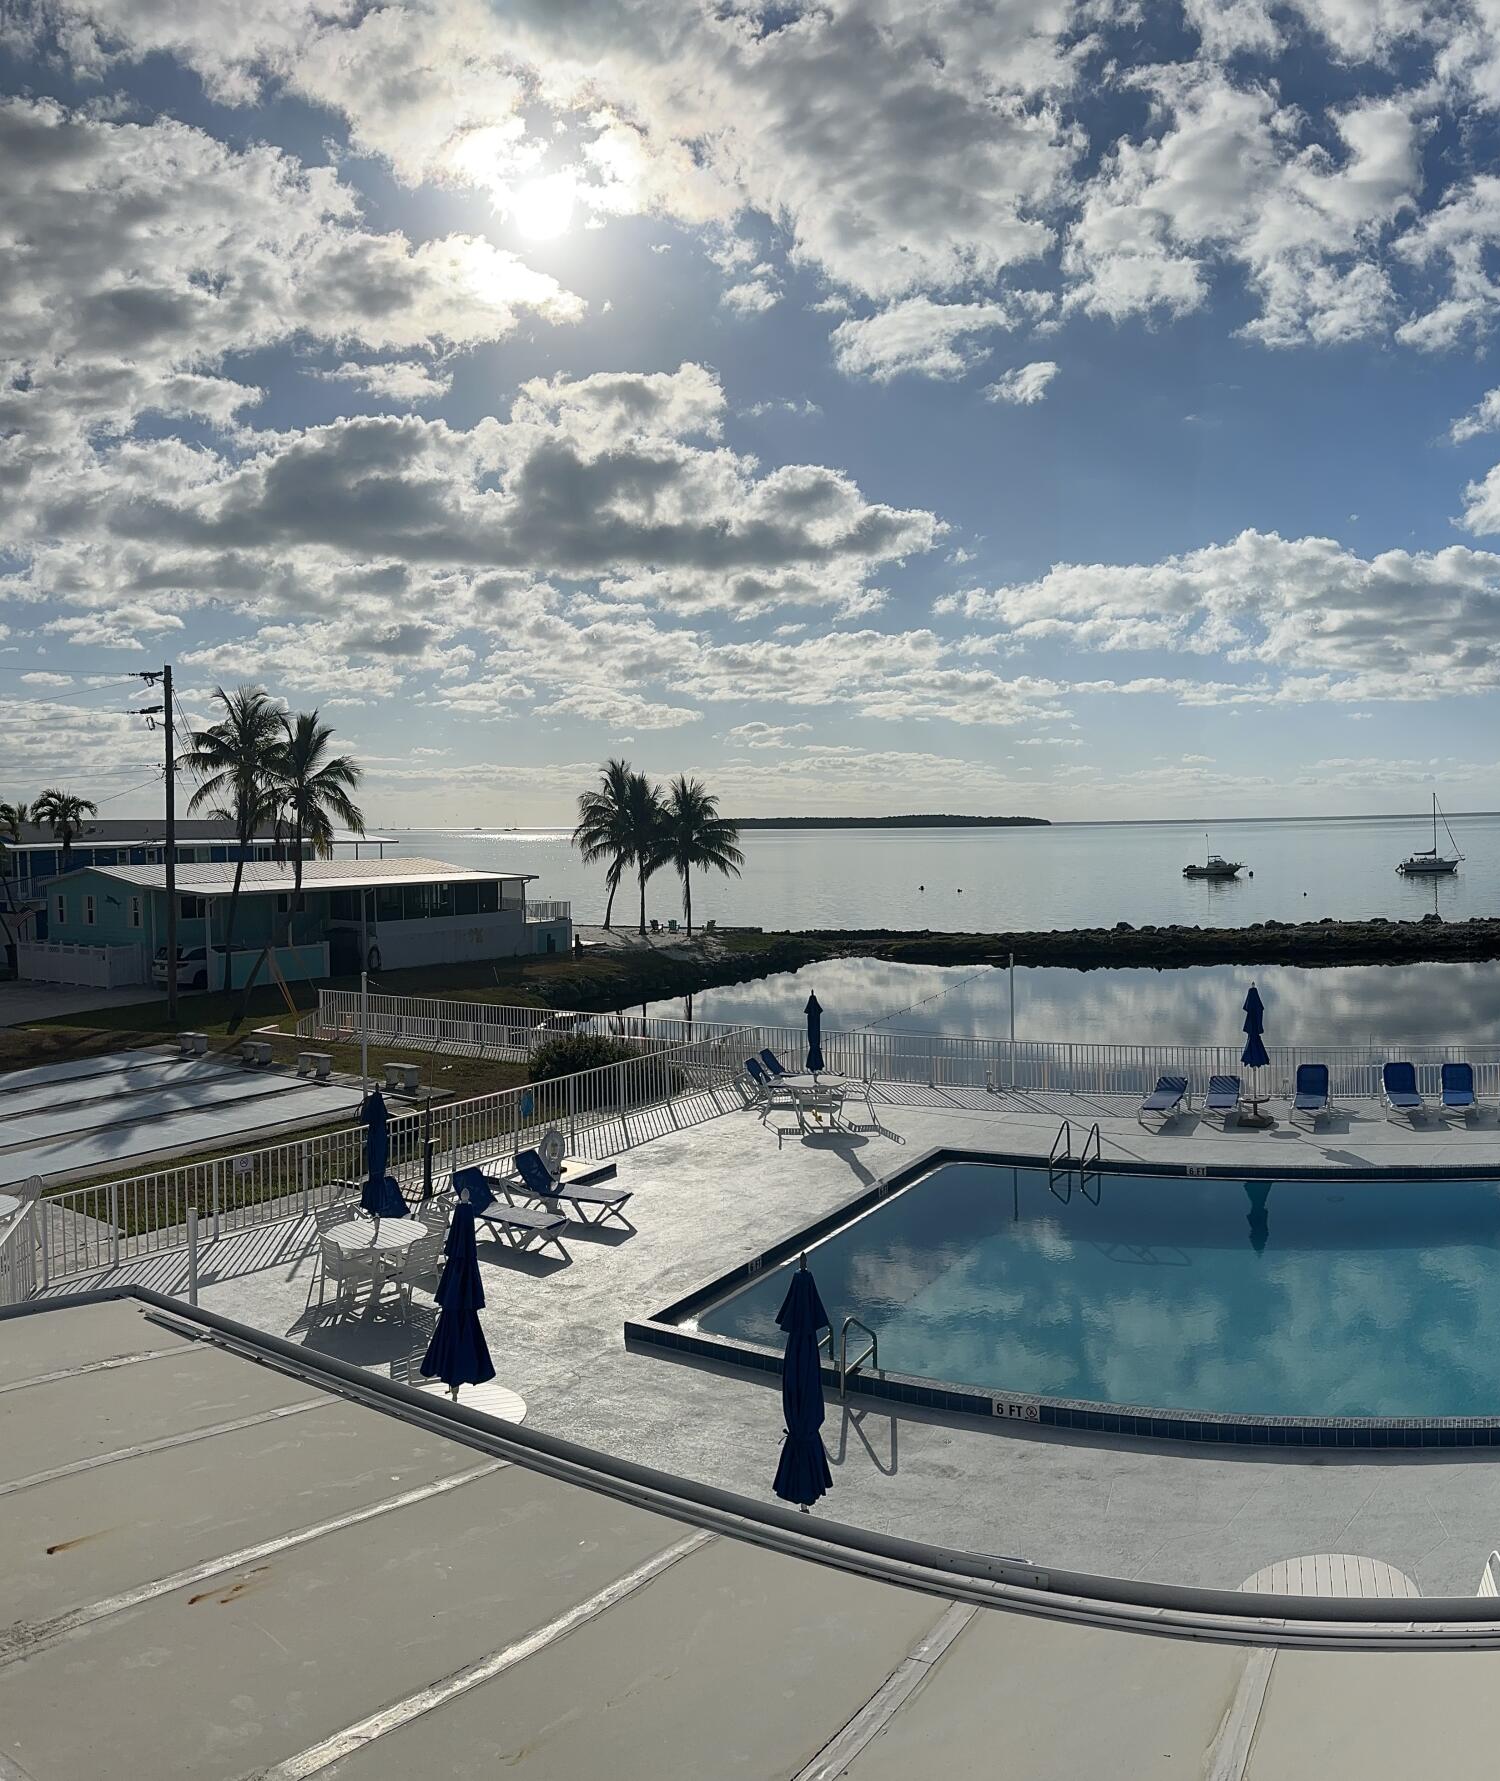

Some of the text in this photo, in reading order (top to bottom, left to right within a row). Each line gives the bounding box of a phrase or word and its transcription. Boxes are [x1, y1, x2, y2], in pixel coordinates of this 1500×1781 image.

[1196, 1167, 1205, 1176] FT
[996, 1402, 1023, 1417] 6 FT
